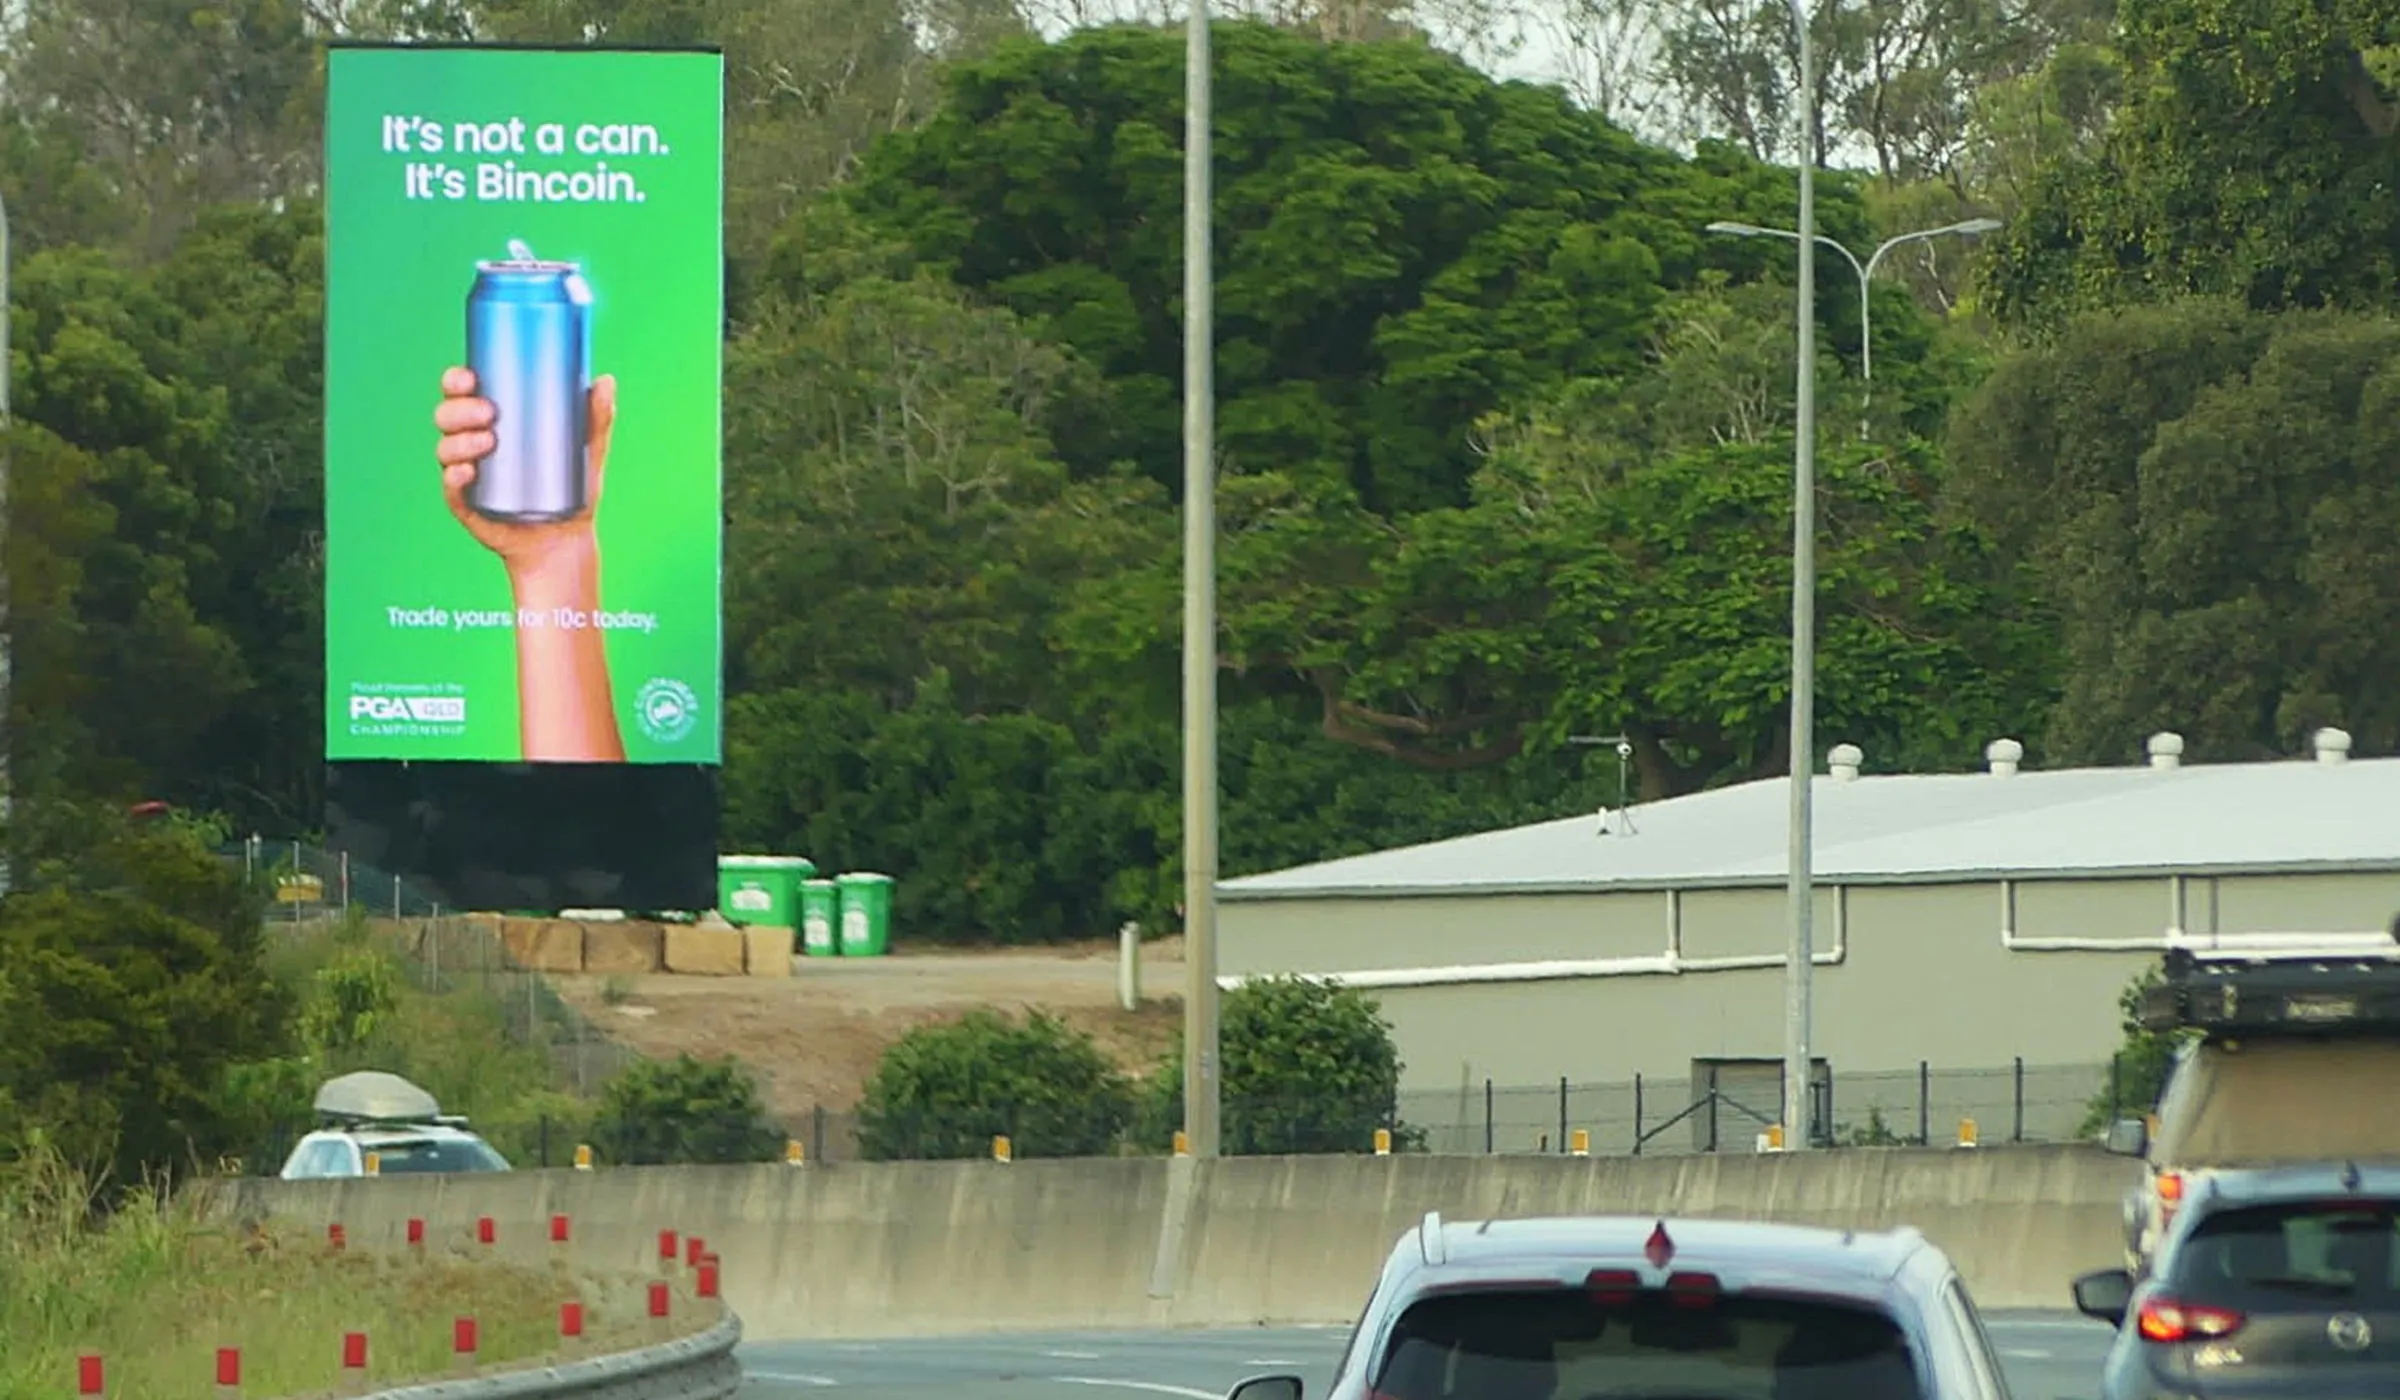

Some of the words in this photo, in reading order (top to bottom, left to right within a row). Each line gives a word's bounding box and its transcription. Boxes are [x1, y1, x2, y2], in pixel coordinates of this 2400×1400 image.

[382, 115, 443, 153] It's
[454, 116, 525, 153] not
[535, 123, 564, 153] a
[575, 123, 669, 154] can.
[405, 163, 466, 198] It's
[476, 160, 646, 202] Bincoin.
[386, 605, 449, 628] Trade
[453, 609, 514, 632] yours
[517, 608, 549, 628] for
[554, 607, 587, 629] 10c
[350, 696, 412, 721] PGA
